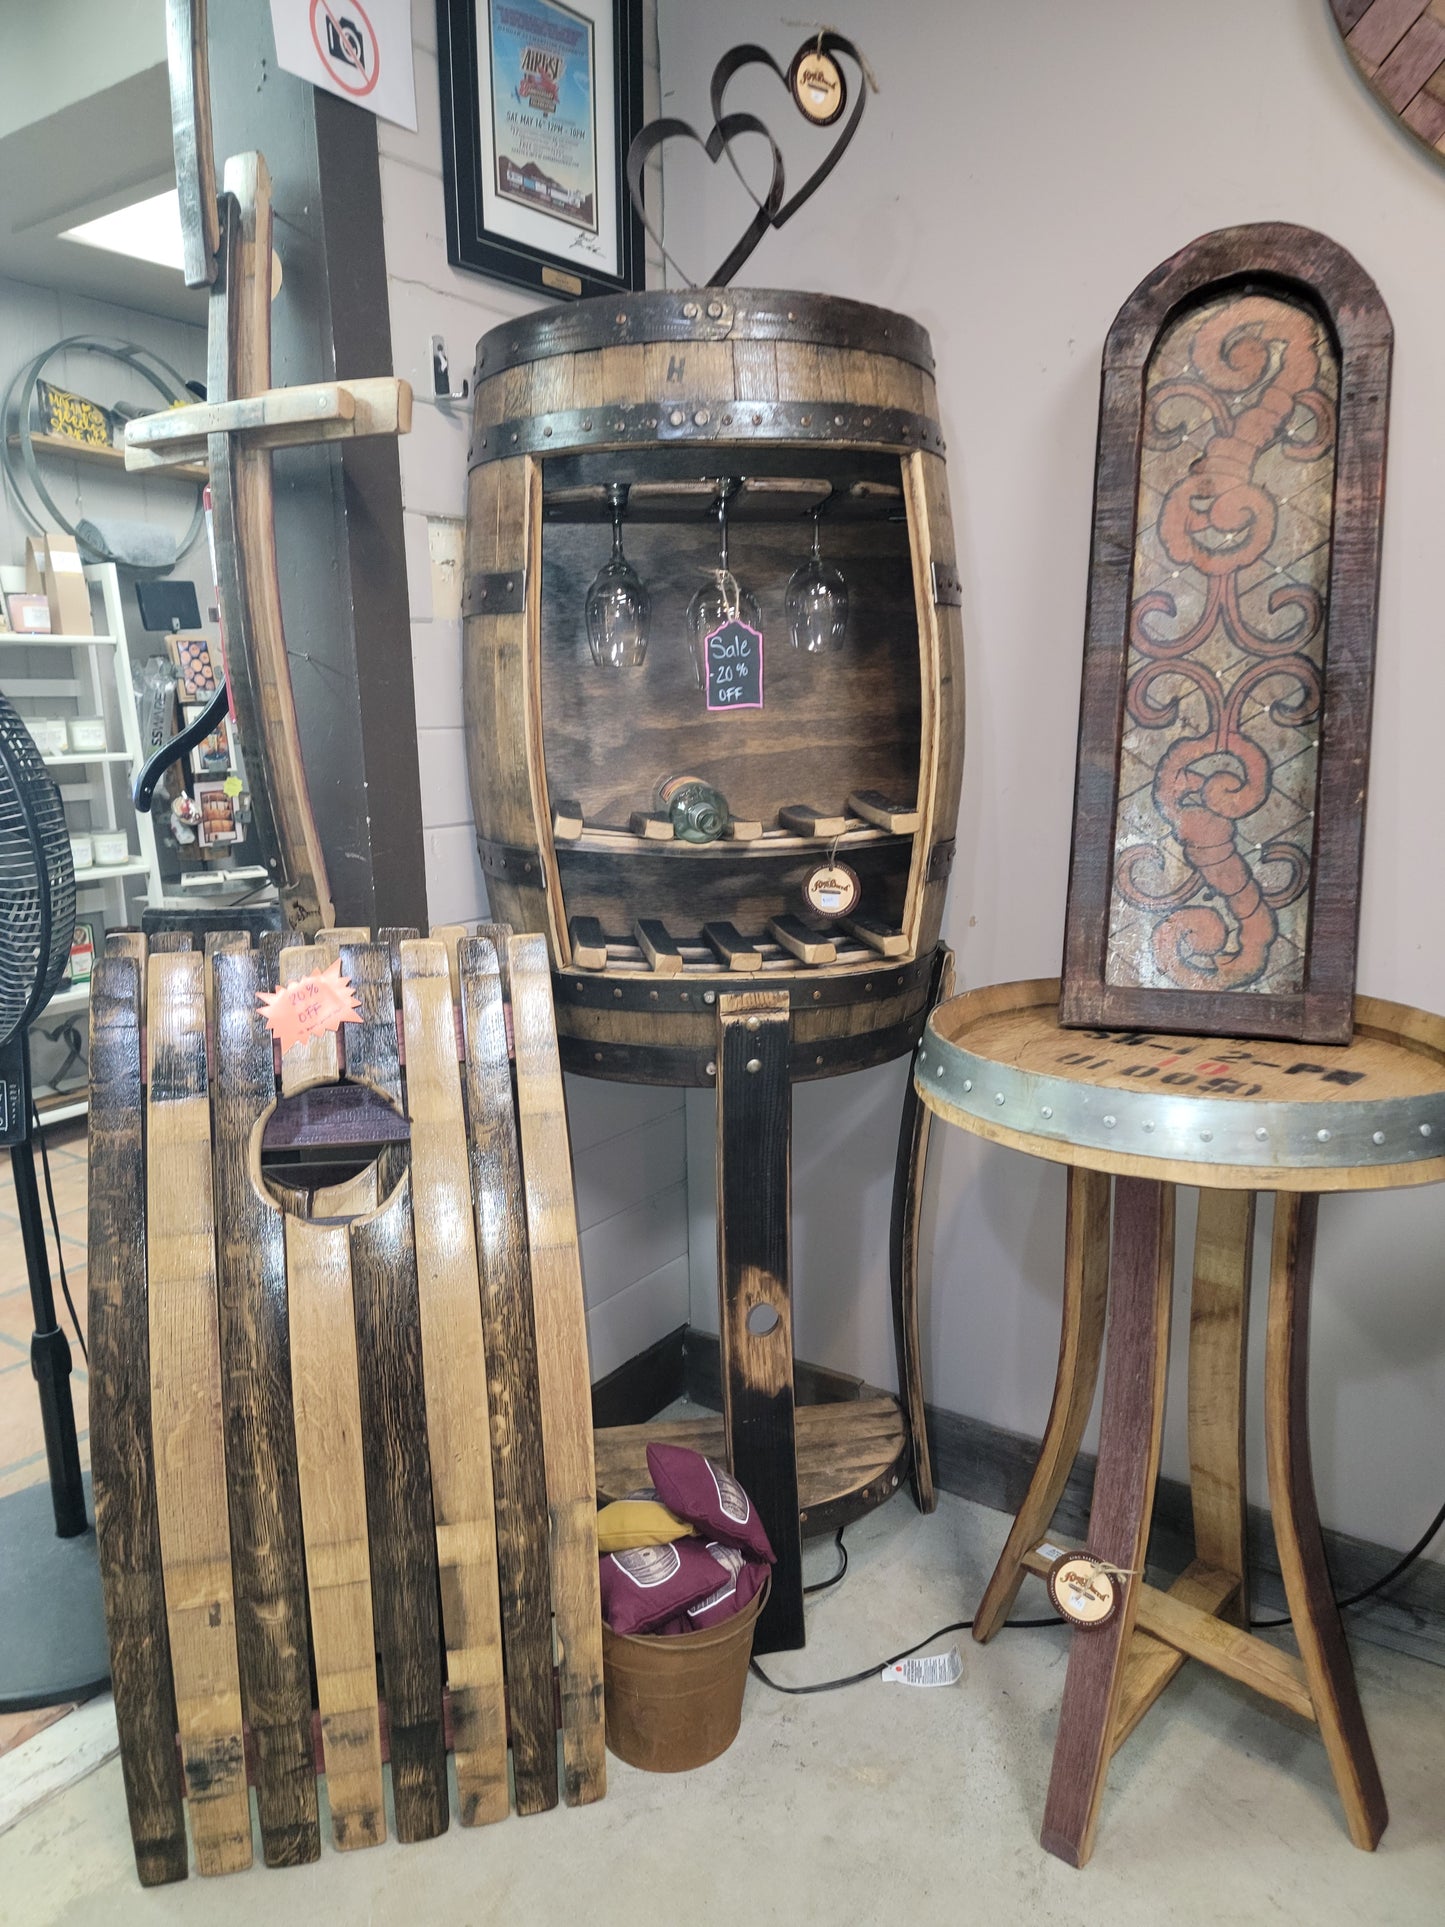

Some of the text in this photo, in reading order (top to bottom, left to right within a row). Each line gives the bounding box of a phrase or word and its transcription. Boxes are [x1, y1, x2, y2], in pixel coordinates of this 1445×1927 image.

[666, 355, 686, 384] H
[710, 635, 751, 659] Sale
[719, 686, 743, 702] OFF
